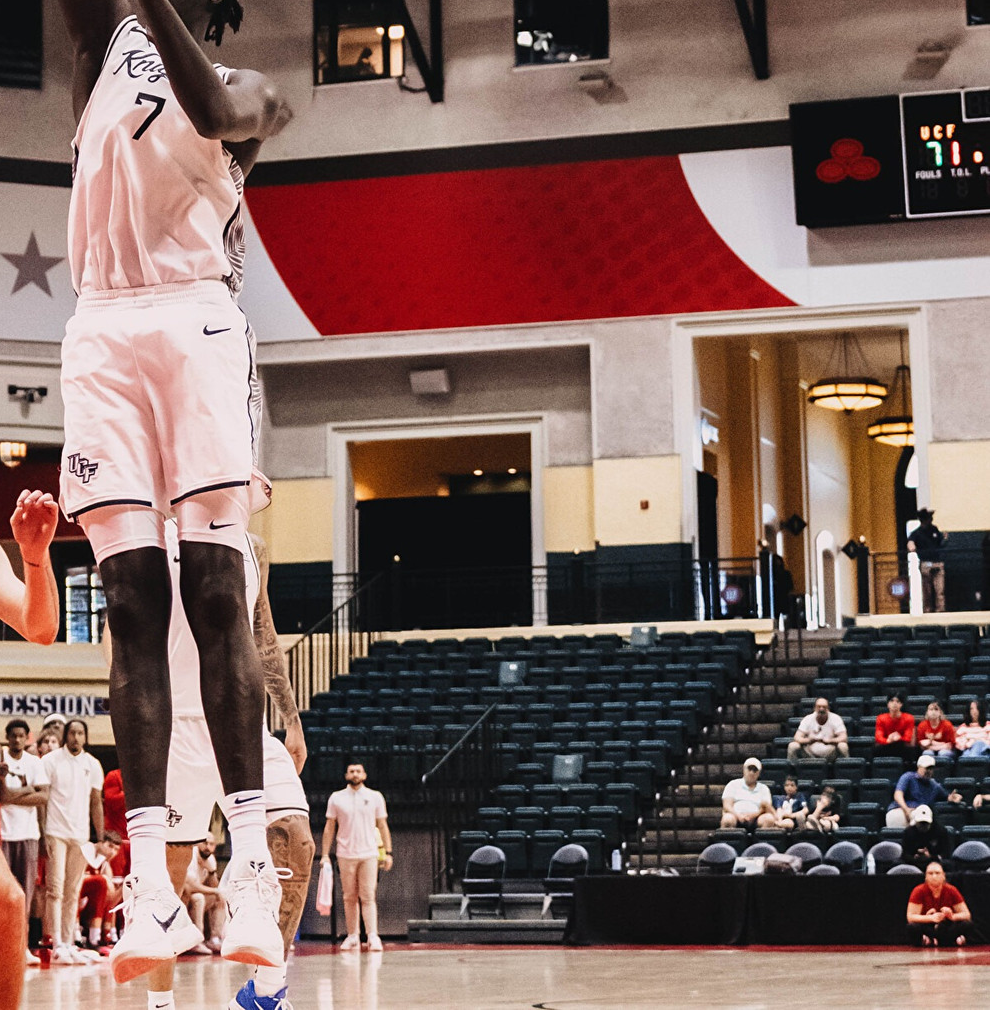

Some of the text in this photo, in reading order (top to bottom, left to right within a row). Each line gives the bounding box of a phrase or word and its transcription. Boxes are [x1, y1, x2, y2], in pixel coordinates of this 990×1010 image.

[132, 92, 166, 140] 7
[919, 123, 956, 140] UCF
[925, 141, 961, 166] 71
[915, 169, 942, 179] FOULS
[67, 452, 98, 484] UCF
